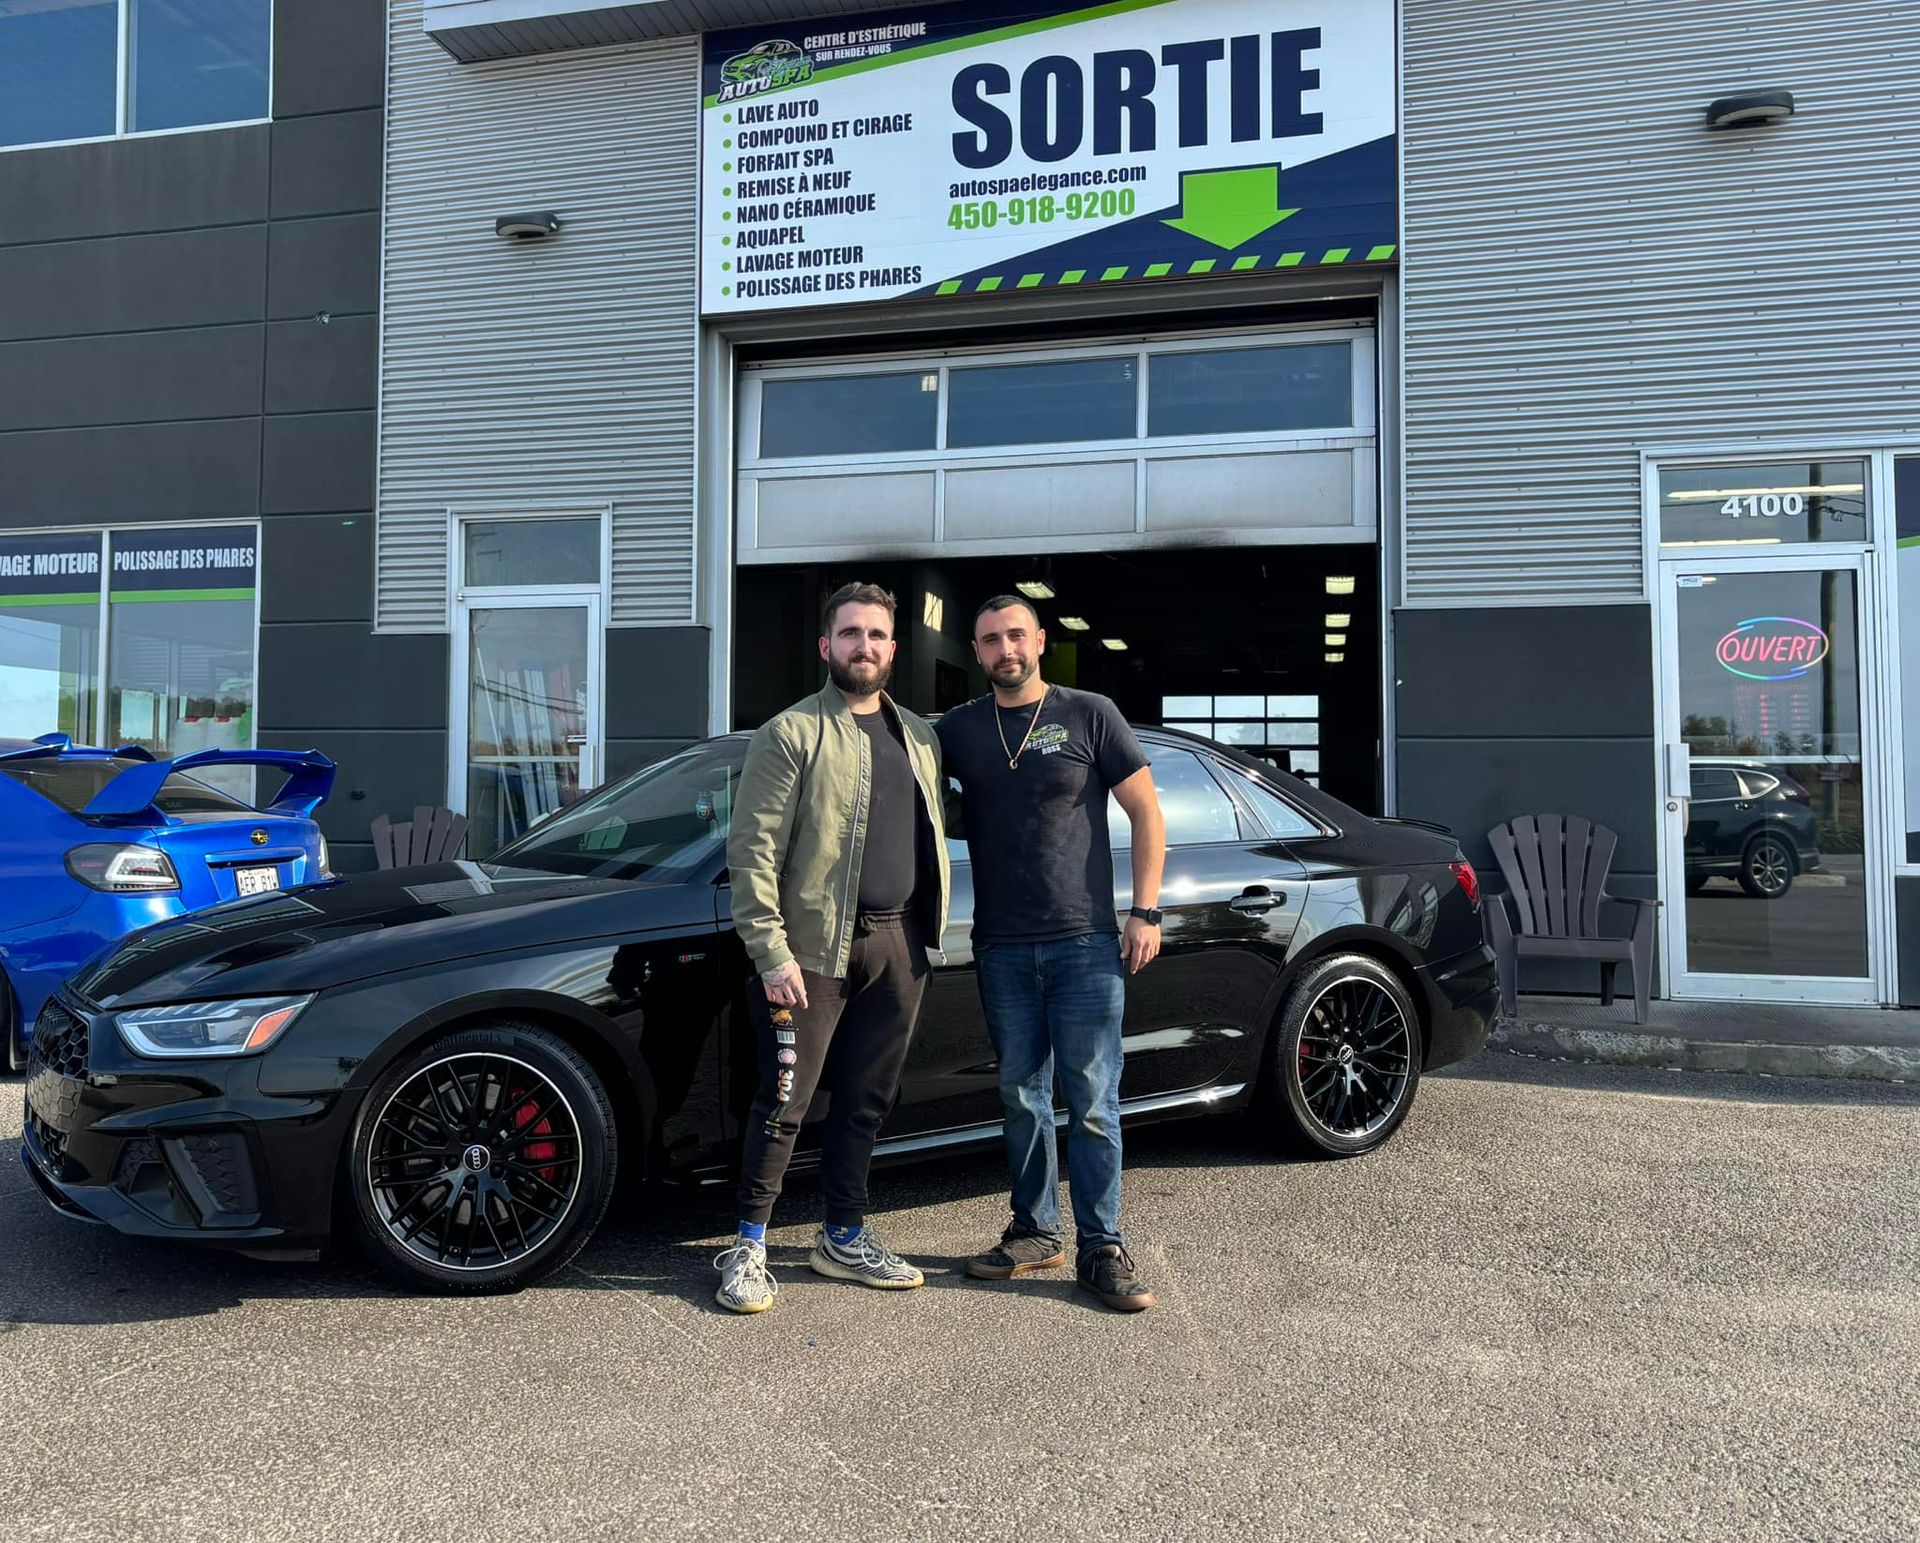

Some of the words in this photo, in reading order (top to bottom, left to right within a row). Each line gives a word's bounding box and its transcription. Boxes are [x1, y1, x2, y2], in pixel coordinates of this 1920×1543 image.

[804, 32, 846, 49] CENTRE
[848, 21, 926, 43] D'ESTHÉTIQUE
[815, 49, 833, 62] SUR
[834, 43, 892, 60] RENDEZ-VOUS
[952, 27, 1324, 168] SORTIE
[738, 105, 774, 125] LAVE
[777, 99, 819, 120] AUTO
[737, 123, 828, 149] COMPOUND
[832, 120, 850, 139] ET
[853, 113, 913, 137] CIRAGE
[737, 151, 800, 174] FORFAIT
[803, 147, 834, 168] SPA
[737, 176, 795, 199] REMISE
[798, 172, 810, 193] À
[812, 170, 852, 192] NEUF
[949, 165, 1147, 199] autospaelegance.com
[737, 203, 780, 224] NANO
[783, 193, 876, 220] CÉRAMIQUE
[947, 188, 1136, 230] 450-918-9200
[736, 226, 805, 249] AQUAPEL
[736, 252, 795, 274] LAVAGE
[797, 245, 864, 269] MOTEUR
[736, 274, 822, 299] POLISSAGE
[825, 271, 856, 292] DES
[859, 265, 922, 289] PHARES
[1720, 494, 1803, 518] 4100
[33, 552, 99, 576] MOTEUR
[113, 549, 181, 571] POLISSAGE
[181, 548, 205, 569] DES
[205, 547, 255, 568] PHARES
[1722, 635, 1821, 662] OUVERT
